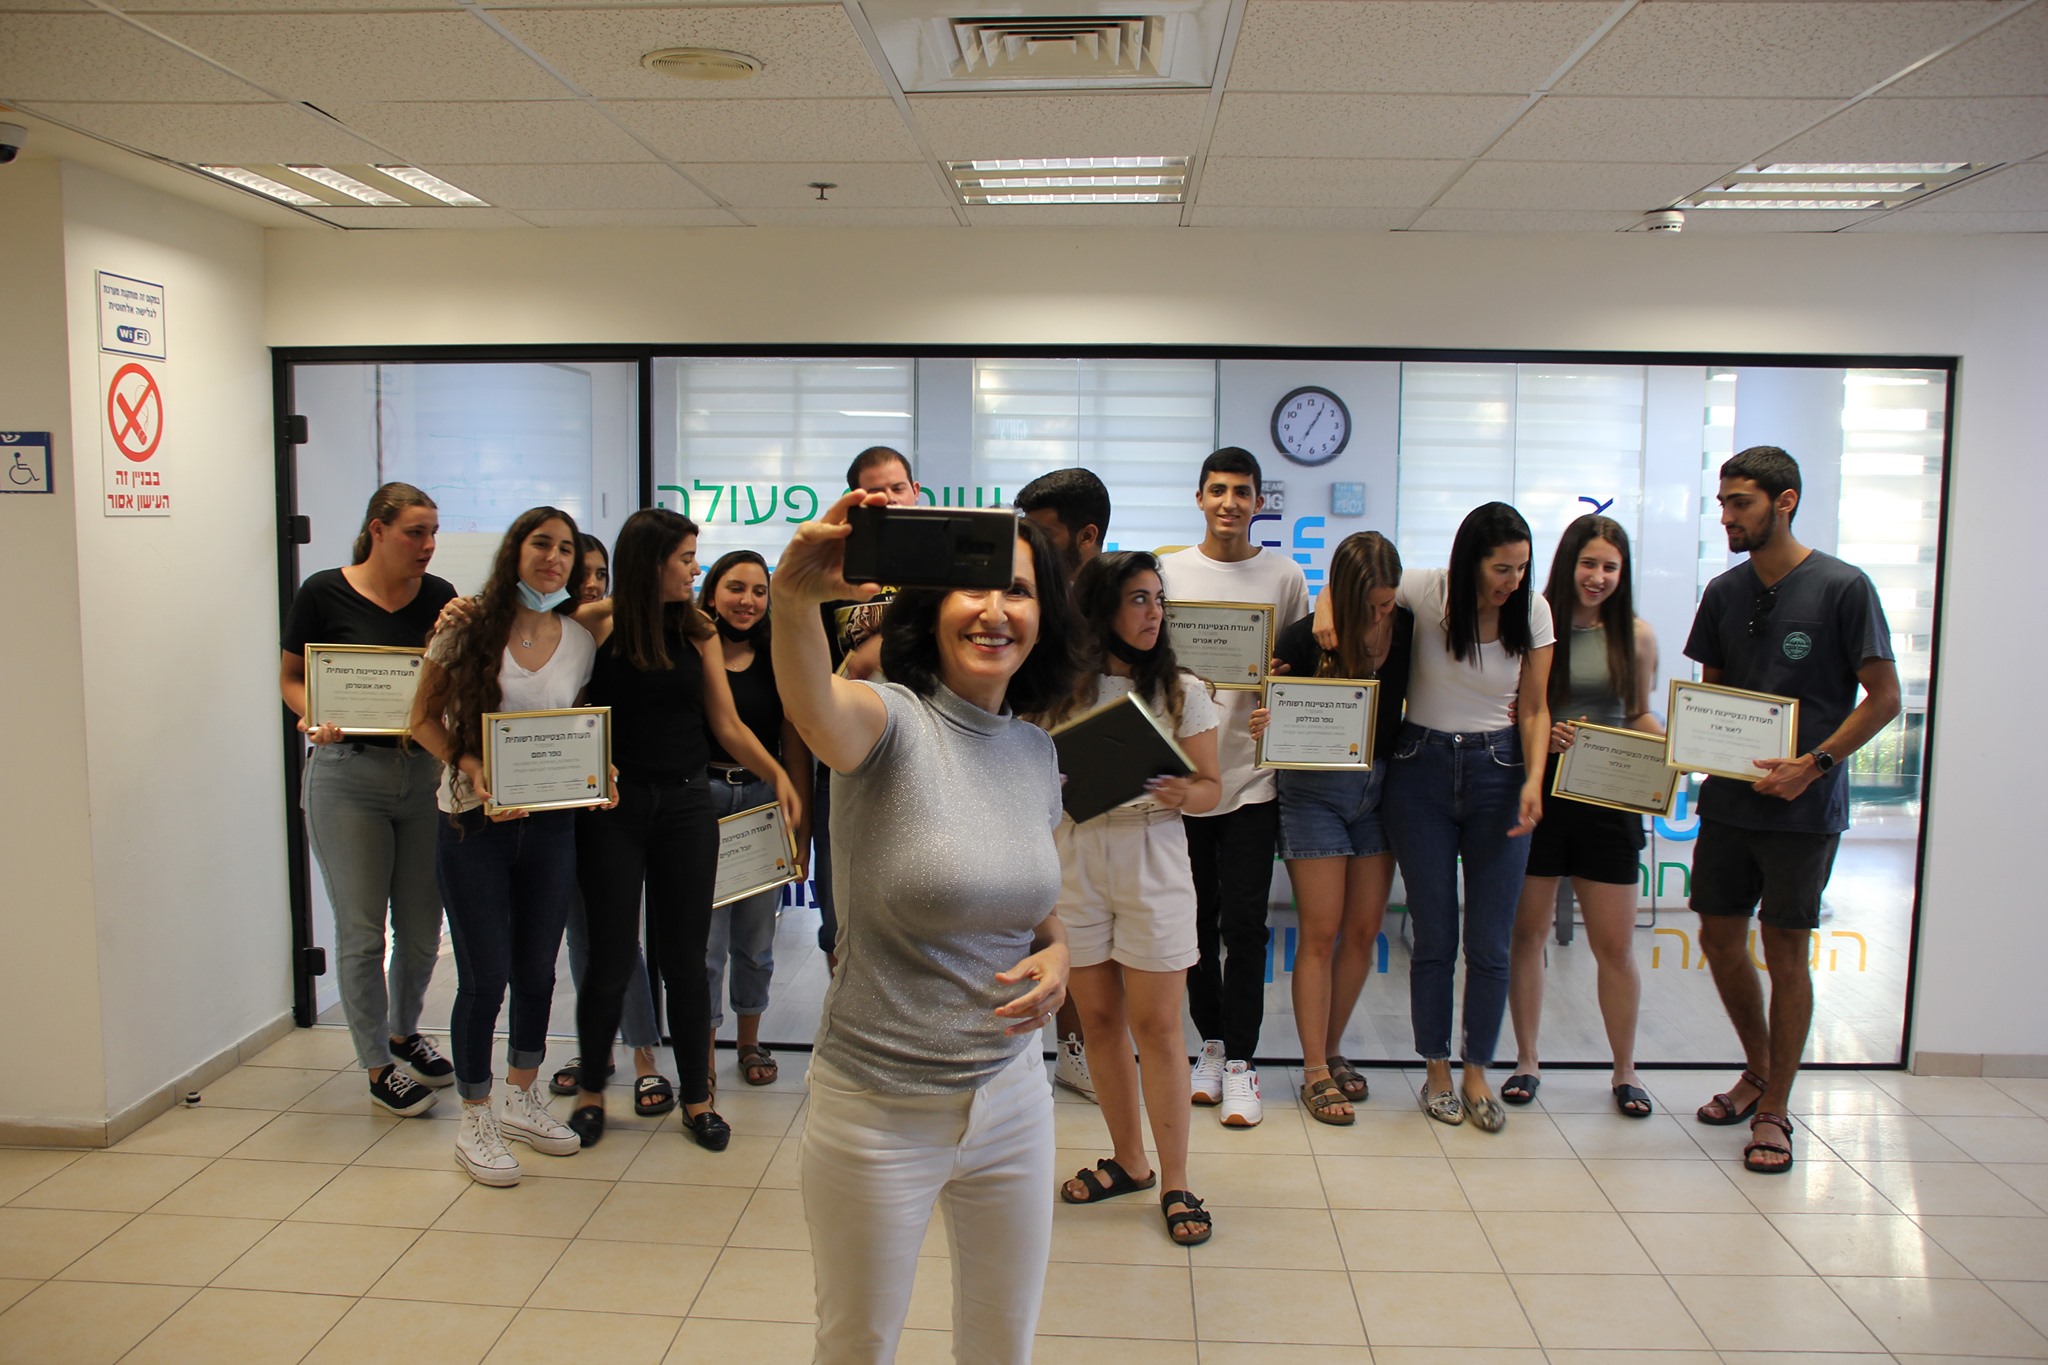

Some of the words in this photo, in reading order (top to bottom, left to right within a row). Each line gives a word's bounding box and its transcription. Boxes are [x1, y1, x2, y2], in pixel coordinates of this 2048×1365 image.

[136, 307, 157, 318] לגלישה
[1296, 402, 1302, 410] 11
[1307, 399, 1315, 407] 12
[1287, 410, 1297, 419] 10
[1330, 409, 1335, 417] 2
[1283, 423, 1290, 431] 9
[1334, 422, 1339, 430] 3
[1287, 435, 1294, 443] 8
[1330, 434, 1336, 442] 4
[1296, 443, 1302, 452] 7
[1309, 446, 1315, 455] 6
[1321, 443, 1327, 451] 5
[116, 470, 128, 485] זה
[132, 471, 160, 488] בבניין
[107, 494, 133, 509] אסור
[137, 494, 170, 511] העישון
[657, 479, 819, 525] פעולה
[1197, 623, 1229, 631] הצטיינות
[1230, 624, 1255, 632] תעודת
[356, 668, 389, 676] הצטיינות
[390, 669, 415, 677] תעודת
[1278, 699, 1303, 707] רשותית
[1304, 700, 1334, 709] הצטיינות
[1335, 701, 1358, 709] תעודת
[1685, 704, 1714, 716] רשותית
[1714, 709, 1747, 721] הצטיינות
[1748, 714, 1774, 725] תעודת
[505, 735, 533, 744] רשותית
[534, 733, 566, 742] הצטיינות
[566, 732, 591, 740] תעודת
[1583, 742, 1610, 753] רשותית
[751, 823, 772, 835] תעודת
